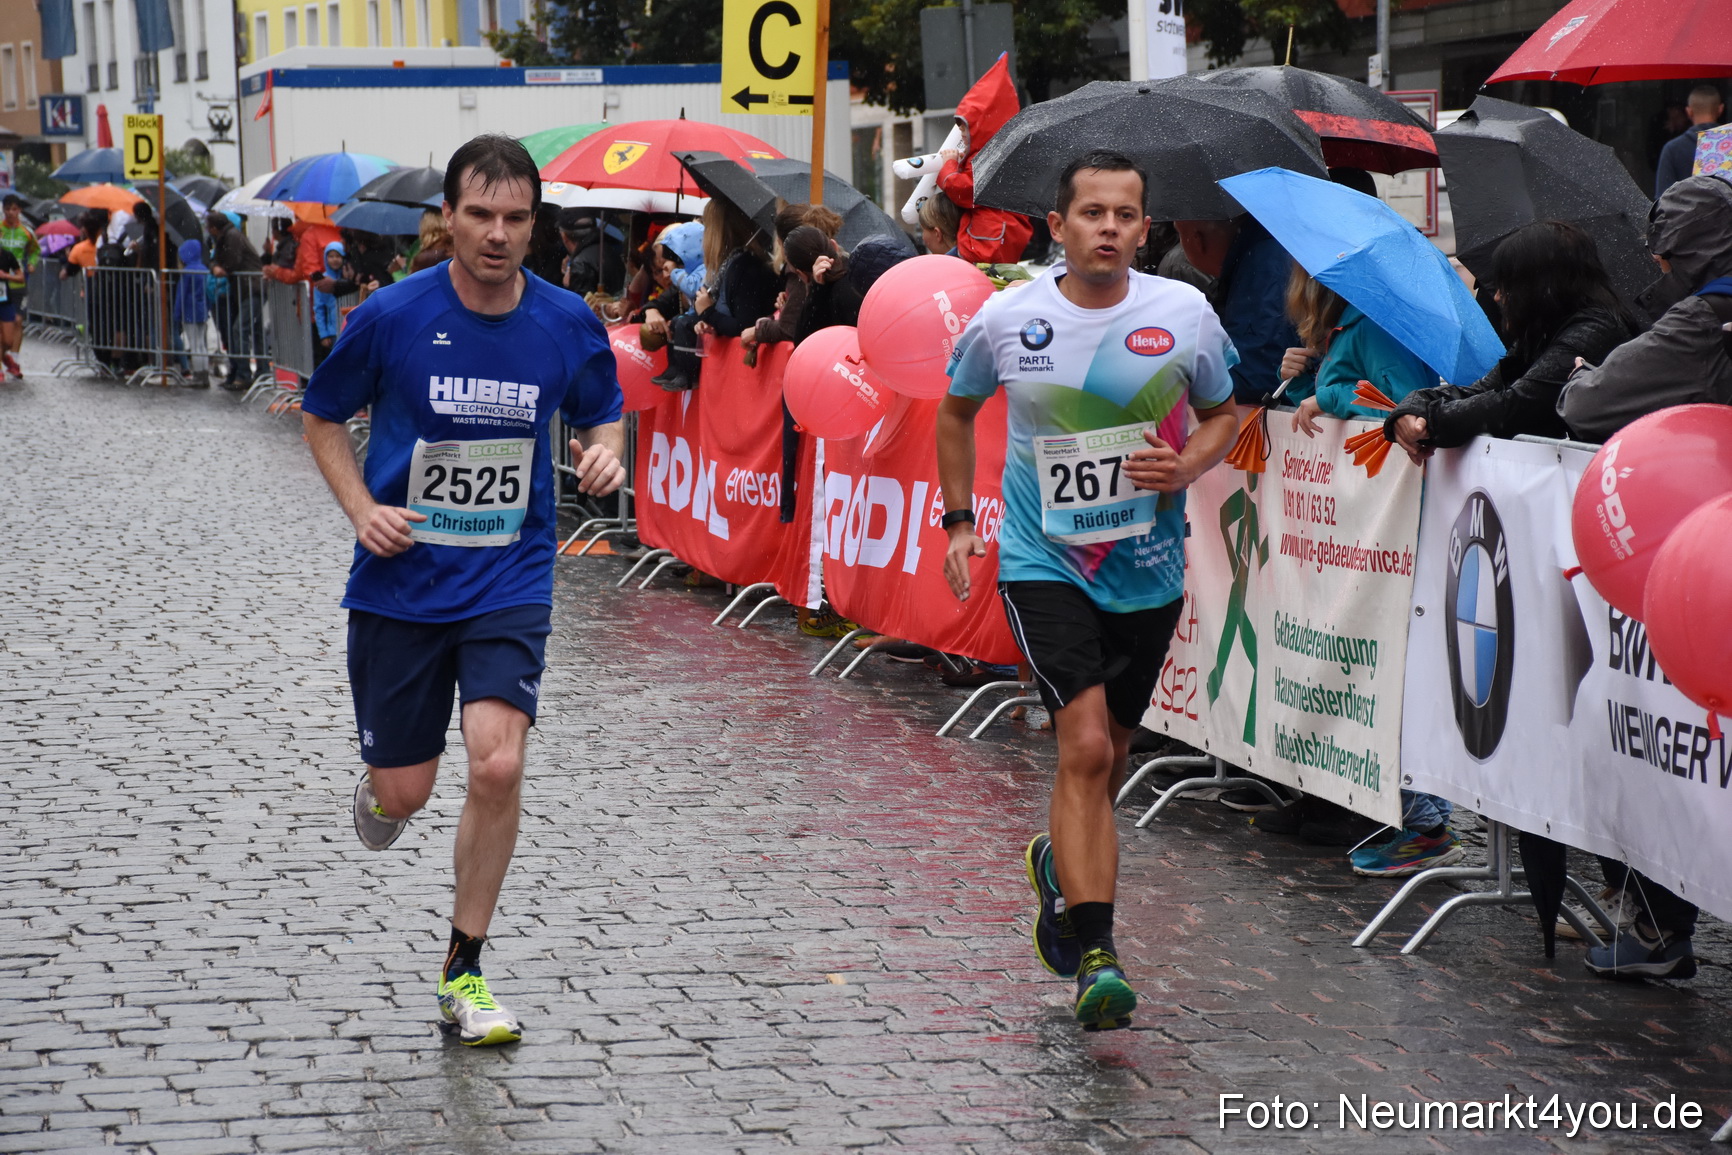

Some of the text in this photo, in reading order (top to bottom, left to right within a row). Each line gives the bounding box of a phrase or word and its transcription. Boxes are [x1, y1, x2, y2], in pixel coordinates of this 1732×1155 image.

[748, 0, 802, 80] C
[127, 116, 159, 128] Block
[134, 134, 154, 164] D
[1132, 335, 1170, 348] Hervis
[1019, 356, 1054, 365] PARTL
[429, 376, 540, 408] HUBER
[832, 362, 880, 405] RÖDL
[453, 403, 534, 419] TECHNOLOGY
[452, 416, 531, 430] WASTE WATER Solutions
[468, 443, 523, 457] BOCK
[1086, 427, 1146, 450] BOCK
[422, 451, 461, 460] NeuerMarkt
[1043, 447, 1081, 456] NeuerMarkt
[1282, 449, 1333, 485] Service-Line:
[422, 464, 520, 506] 2525
[1050, 454, 1144, 504] 267
[1601, 438, 1636, 556] RÖDL
[431, 512, 505, 535] Christoph
[1073, 508, 1135, 530] Rüdiger
[1274, 609, 1378, 681] Gebäudereinigung
[1274, 666, 1376, 728] Hausmeisterdienst
[363, 729, 374, 747] 36
[1608, 699, 1712, 784] WENIGER
